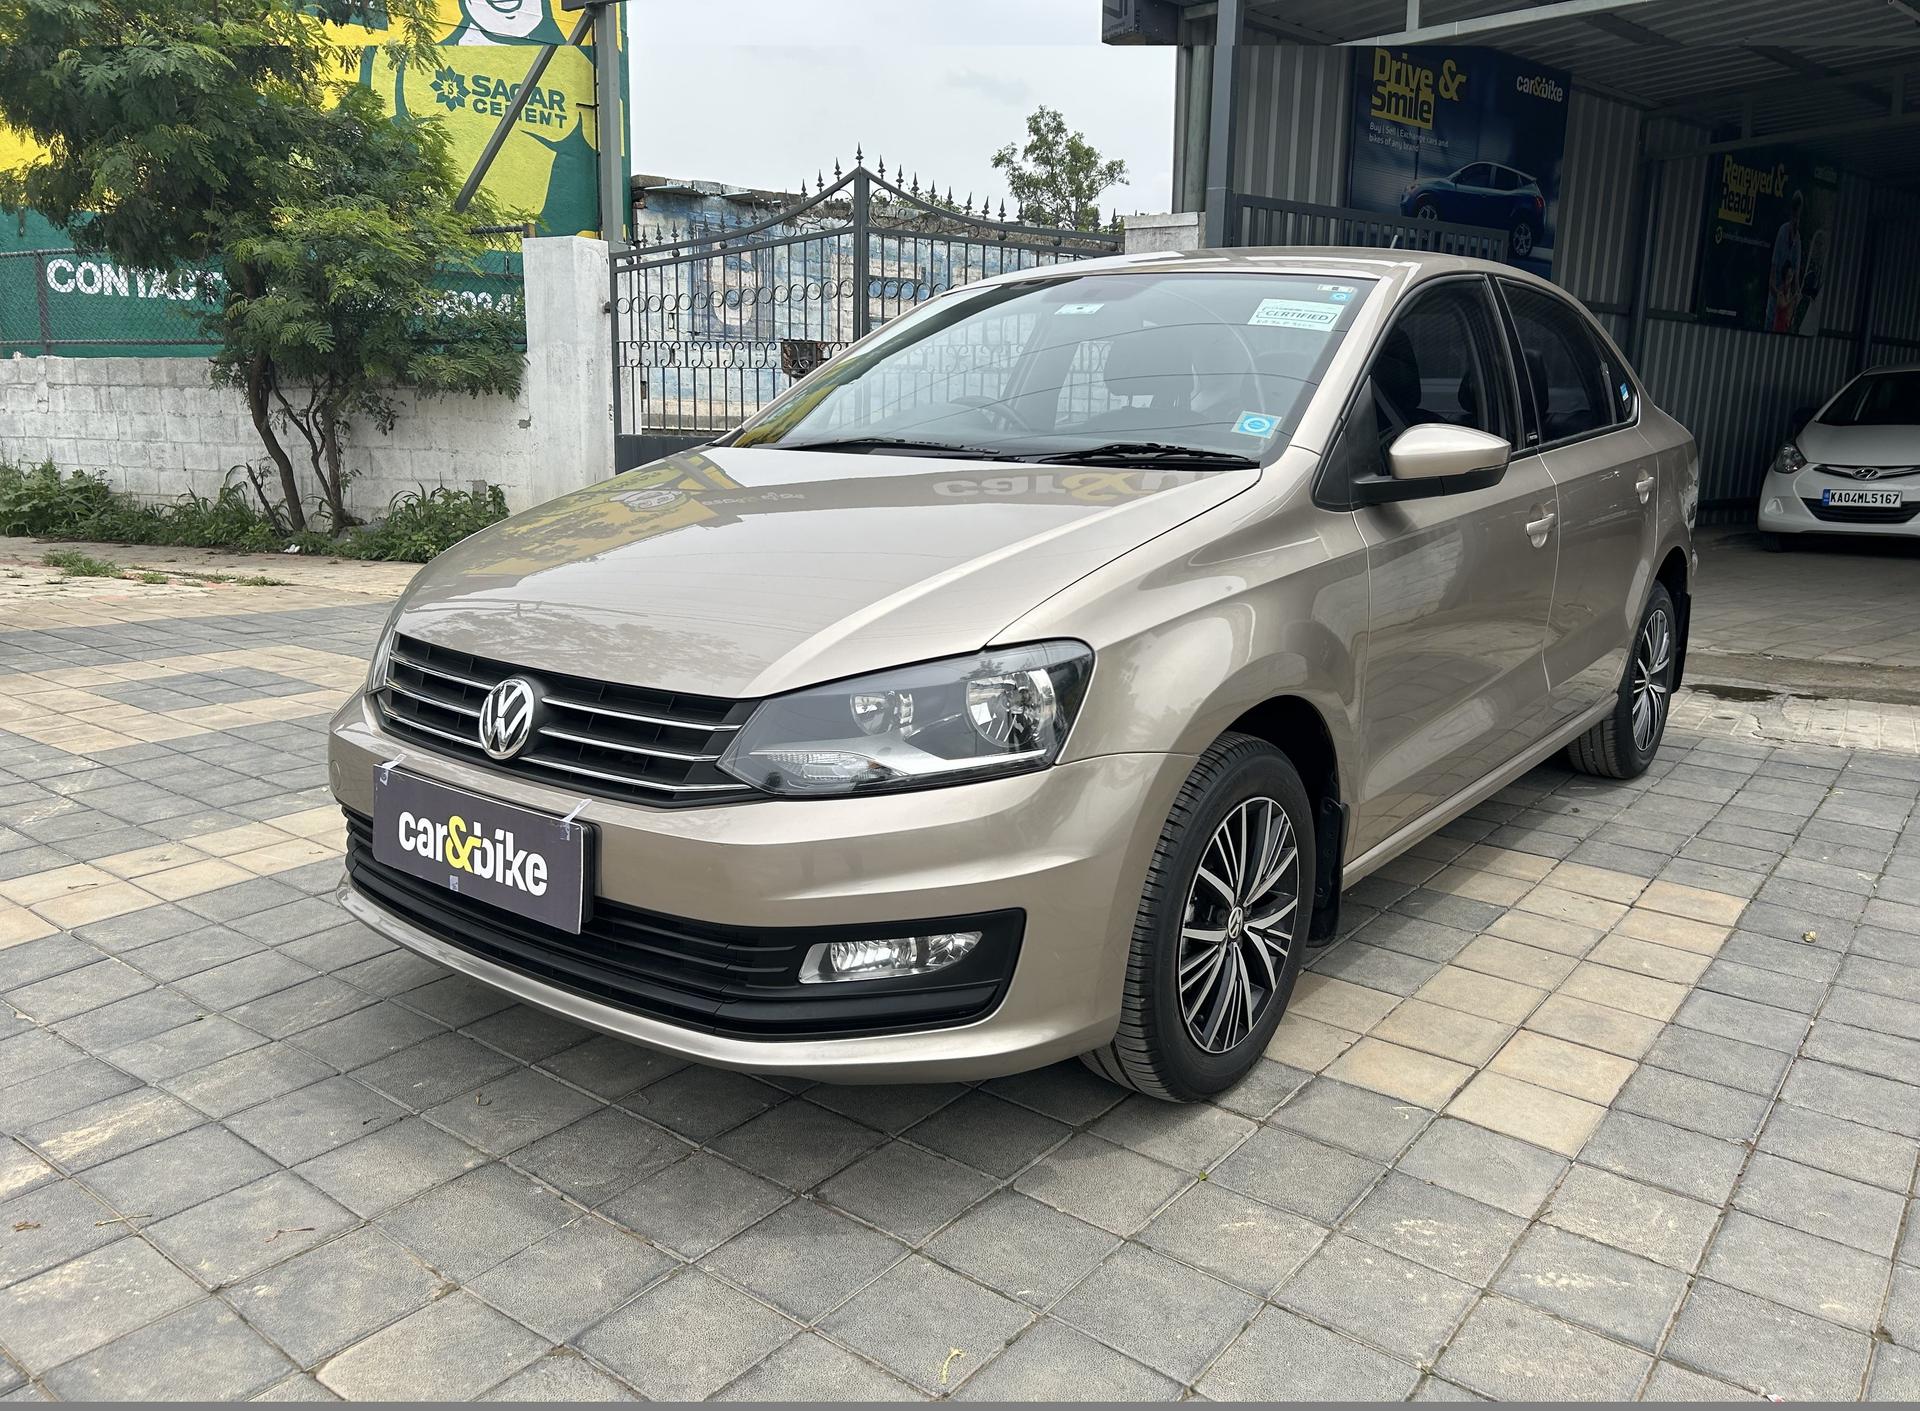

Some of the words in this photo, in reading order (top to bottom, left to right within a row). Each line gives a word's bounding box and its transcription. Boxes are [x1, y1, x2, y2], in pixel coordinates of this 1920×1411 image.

[1373, 47, 1434, 92] Drive
[1439, 59, 1467, 101] &
[1516, 76, 1563, 102] car&bike
[472, 98, 567, 128] CEENT
[1371, 81, 1433, 124] Smile
[1369, 121, 1382, 134] Buy
[1722, 153, 1775, 195] Renewed
[1721, 182, 1754, 222] Ready
[1265, 310, 1329, 321] CERTIFIED
[1830, 492, 1899, 504] KA04ML5167
[398, 811, 548, 897] car&bike
